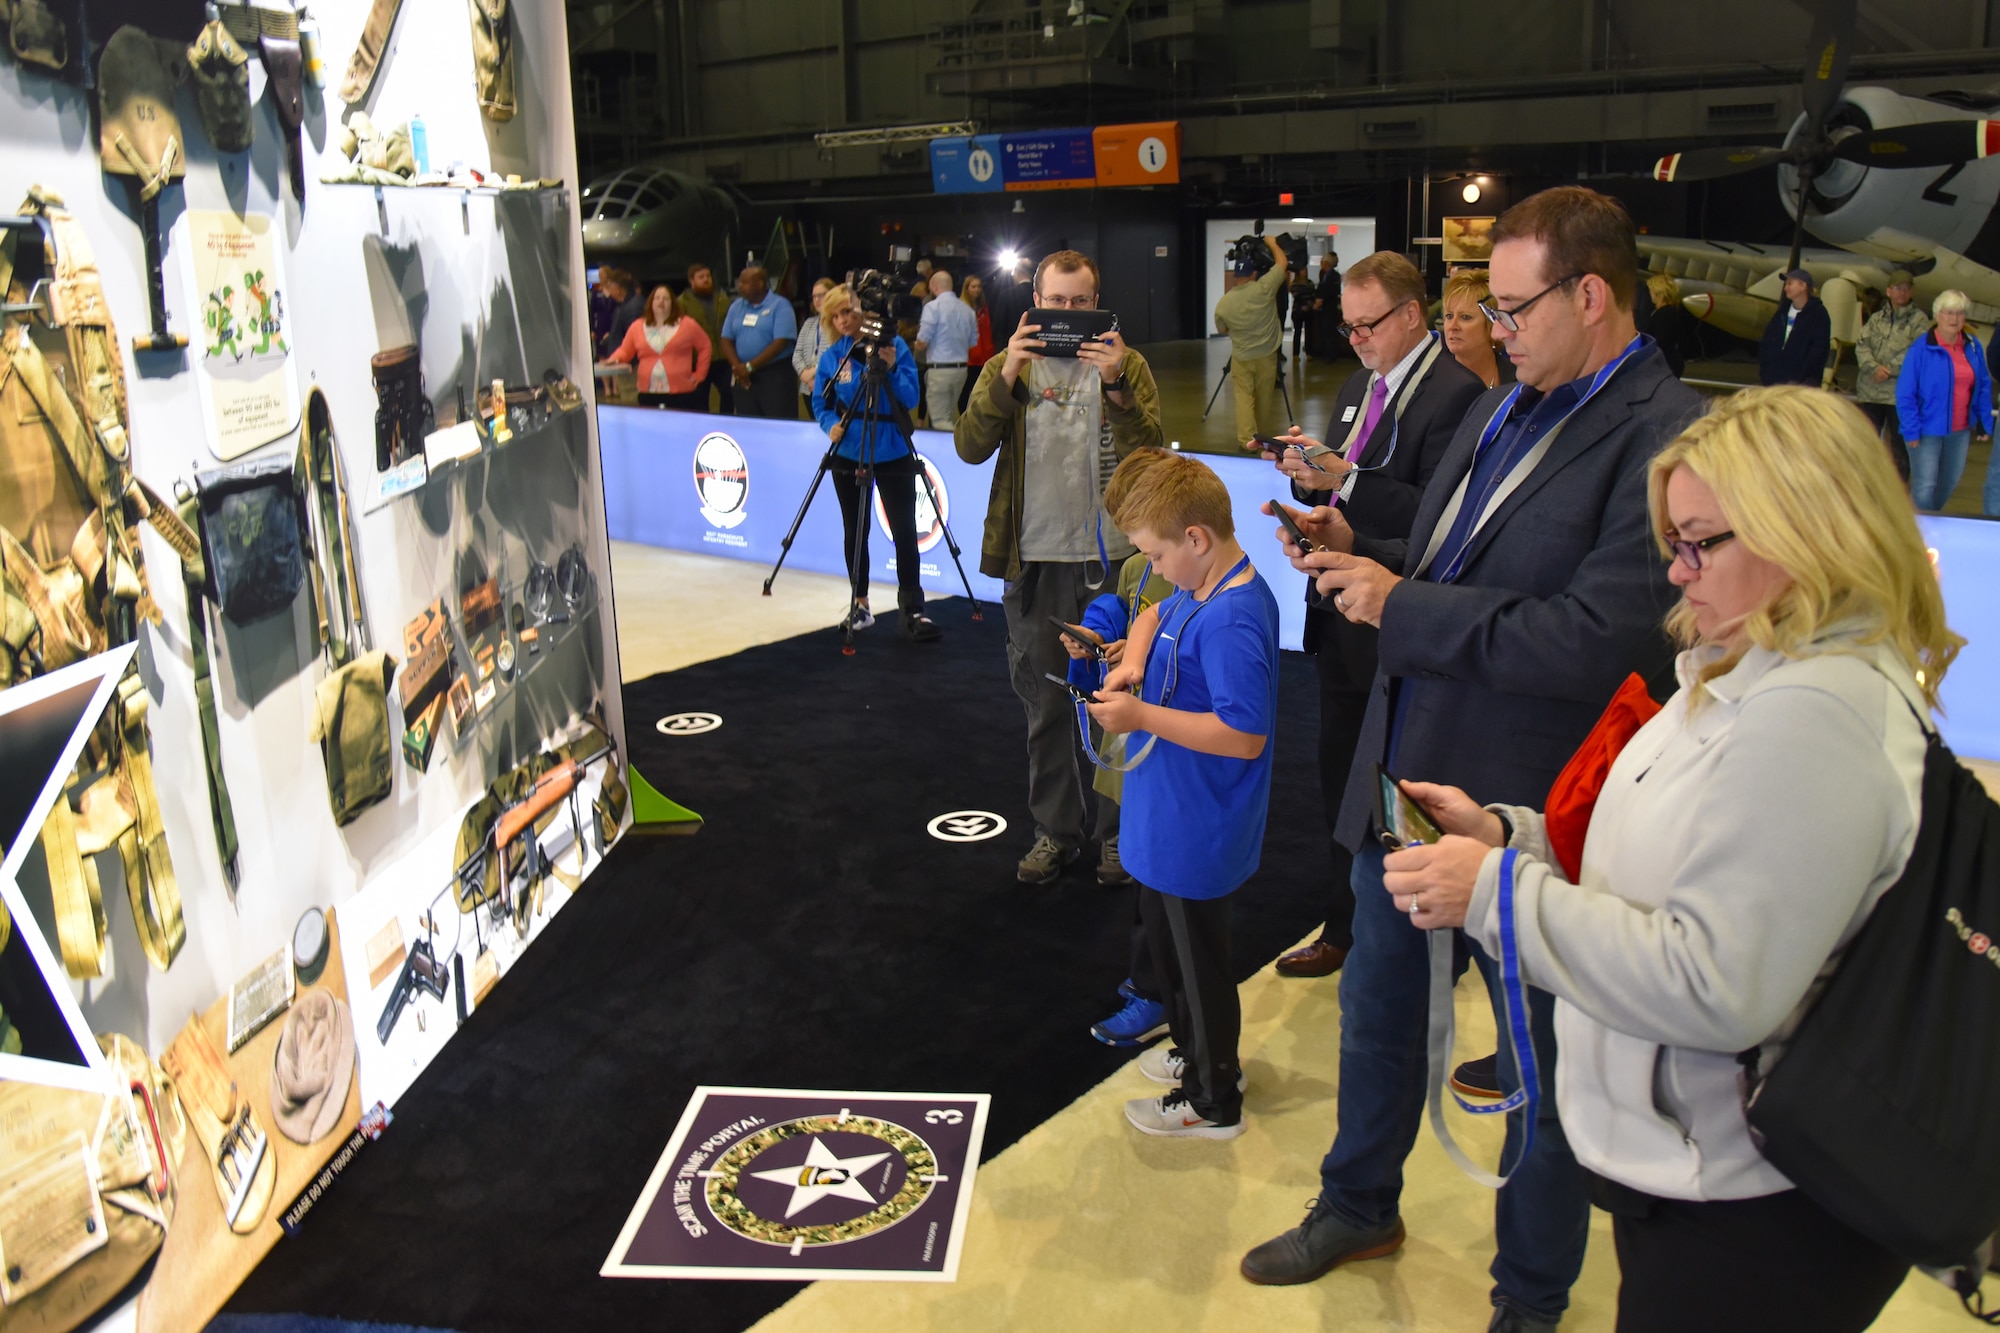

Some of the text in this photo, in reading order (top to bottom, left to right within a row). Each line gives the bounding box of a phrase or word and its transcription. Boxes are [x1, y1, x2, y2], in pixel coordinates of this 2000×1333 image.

[924, 1108, 964, 1126] 3
[286, 1194, 313, 1229] PLEASE
[308, 1183, 322, 1202] DO
[318, 1169, 335, 1191] NOT
[331, 1146, 354, 1175] TOUCH
[349, 1132, 365, 1153] THE
[673, 1115, 766, 1239] SCAN THE TIME PORTAL
